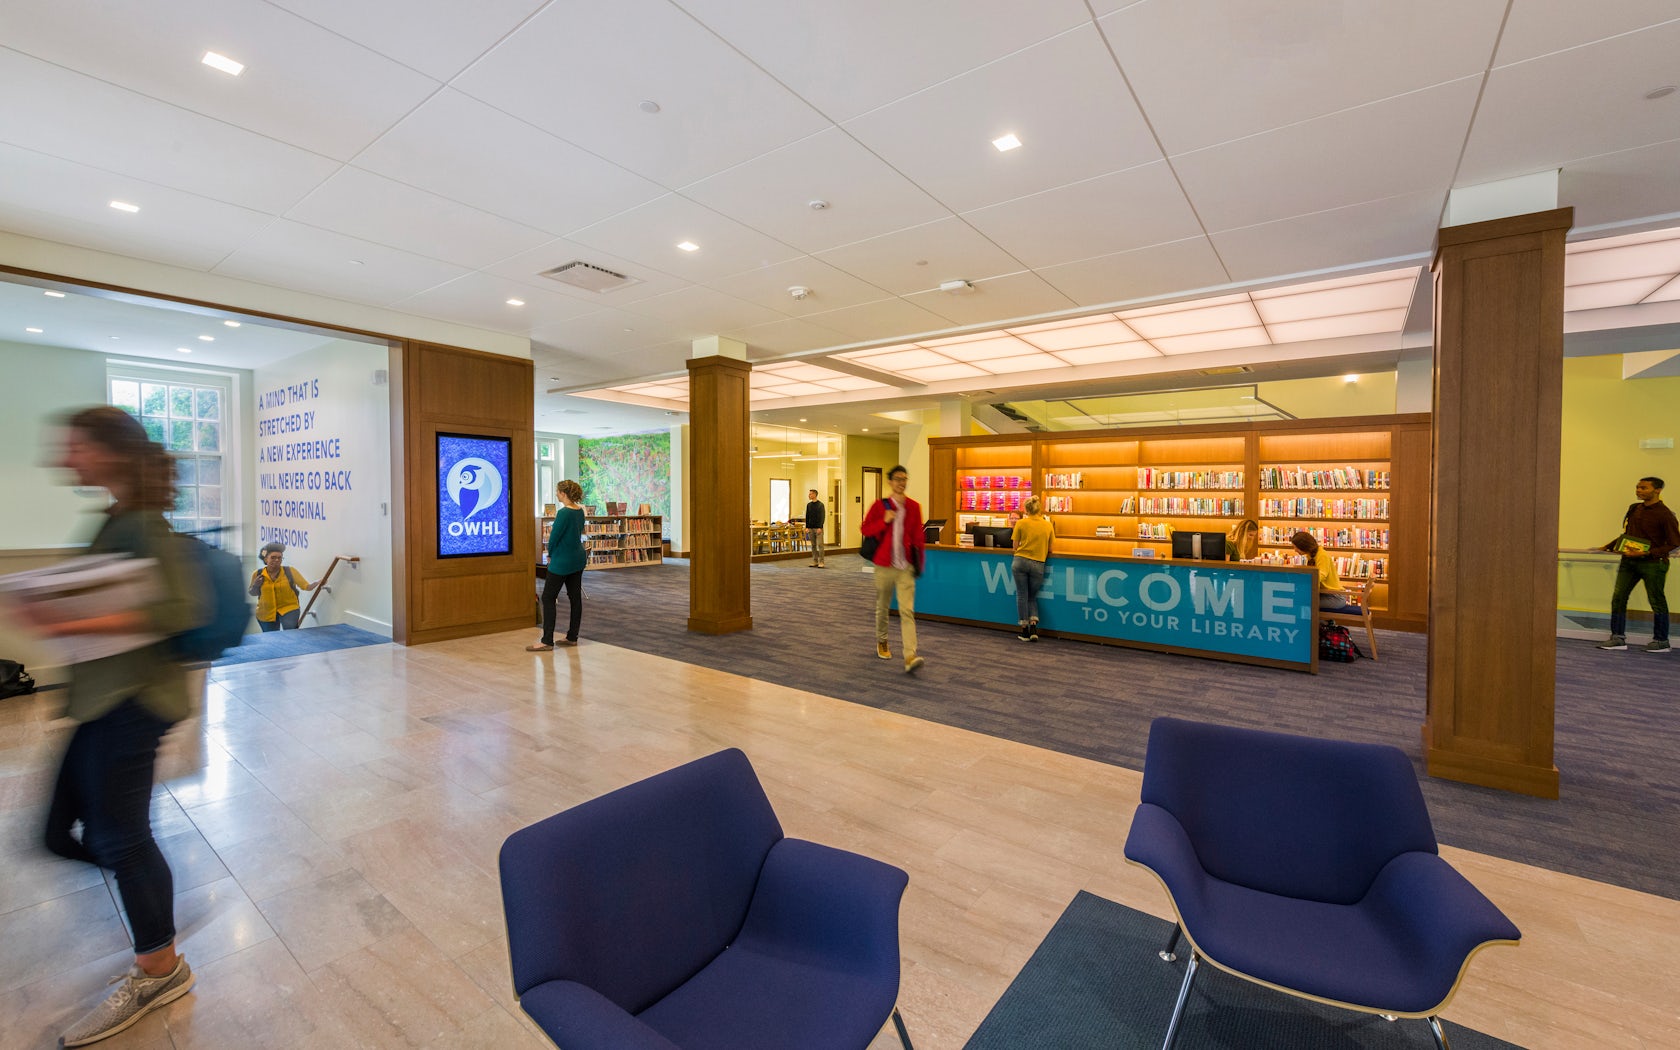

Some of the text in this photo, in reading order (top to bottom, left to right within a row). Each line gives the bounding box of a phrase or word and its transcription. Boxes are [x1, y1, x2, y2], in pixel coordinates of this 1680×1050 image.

[259, 378, 319, 411] A MIND THAT IS
[259, 410, 315, 438] STRETCHED BY
[260, 438, 341, 463] A NEW EXPERIENCE
[261, 470, 352, 491] WILL NEVER GO BACK
[261, 499, 326, 521] TO ITS ORIGINAL
[260, 525, 309, 549] DIMENSIONS
[448, 521, 502, 537] OWHL
[981, 560, 1297, 625] WELCOME
[1081, 606, 1299, 645] TO YOUR LIBRARY
